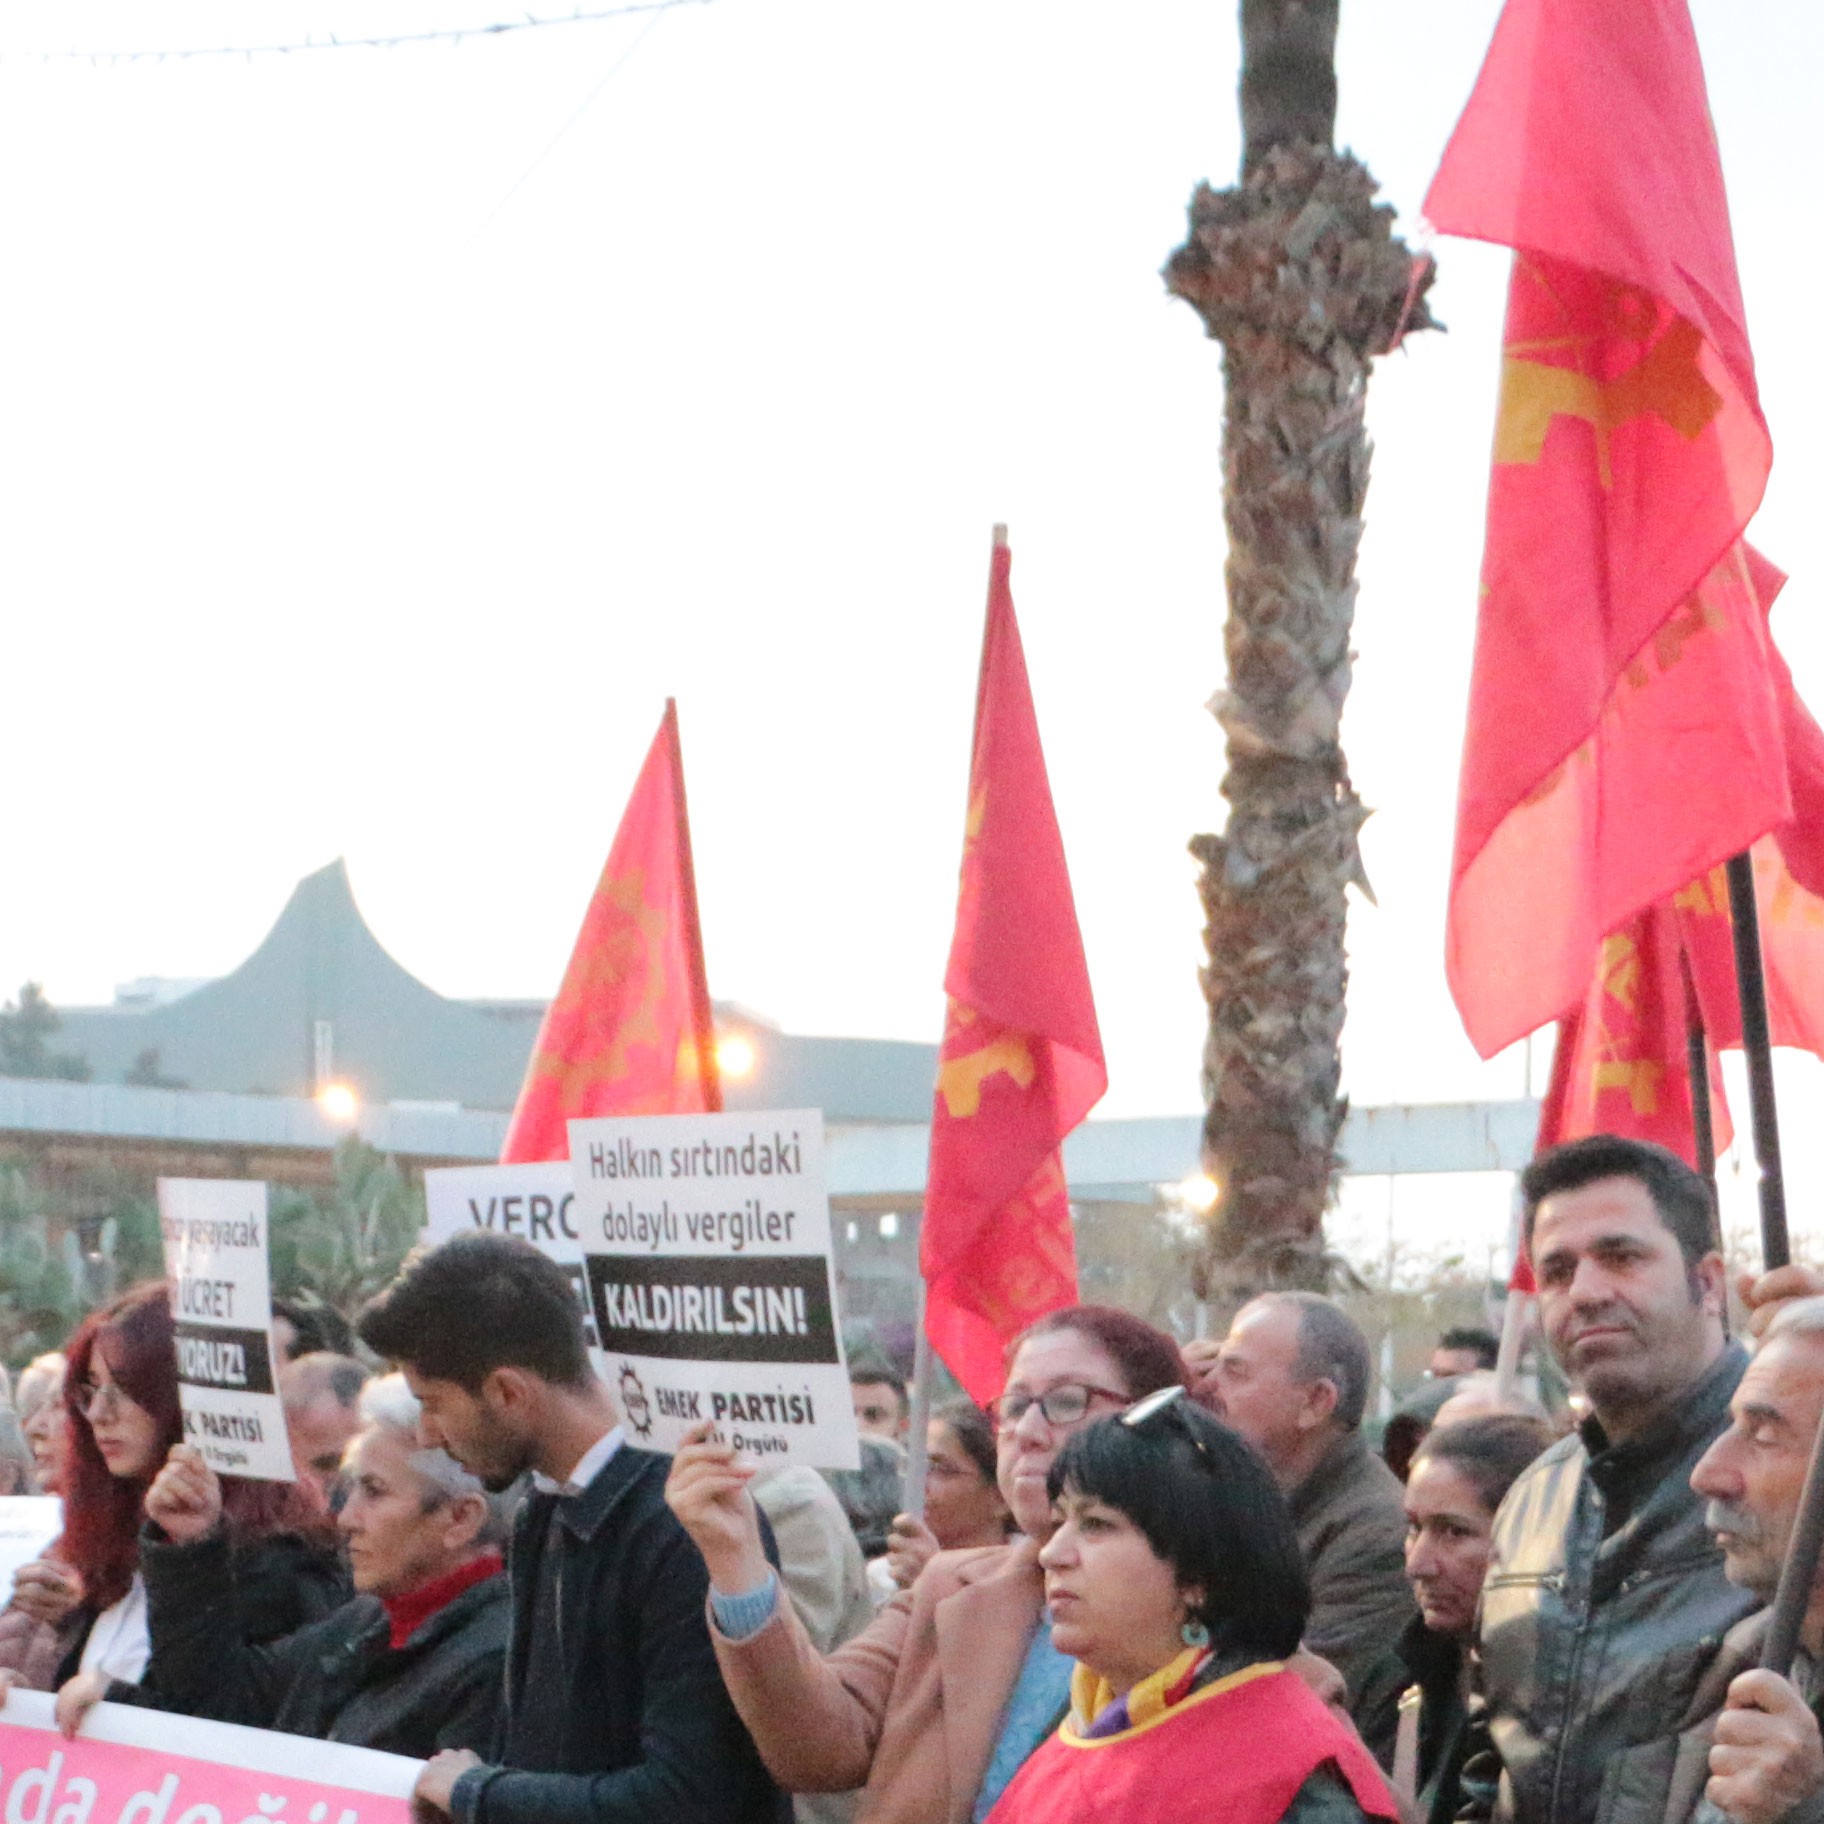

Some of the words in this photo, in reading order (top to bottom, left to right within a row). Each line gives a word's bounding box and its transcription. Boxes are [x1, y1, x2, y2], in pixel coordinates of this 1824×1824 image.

[589, 1137, 662, 1178] Halkın
[670, 1131, 801, 1177] sırtındaki
[603, 1201, 677, 1250] dolaylı
[685, 1199, 796, 1251] vergiler
[604, 1282, 808, 1335] KALDIRILSIN!
[655, 1387, 701, 1419] EMEK
[710, 1385, 816, 1424] PARTİSİ
